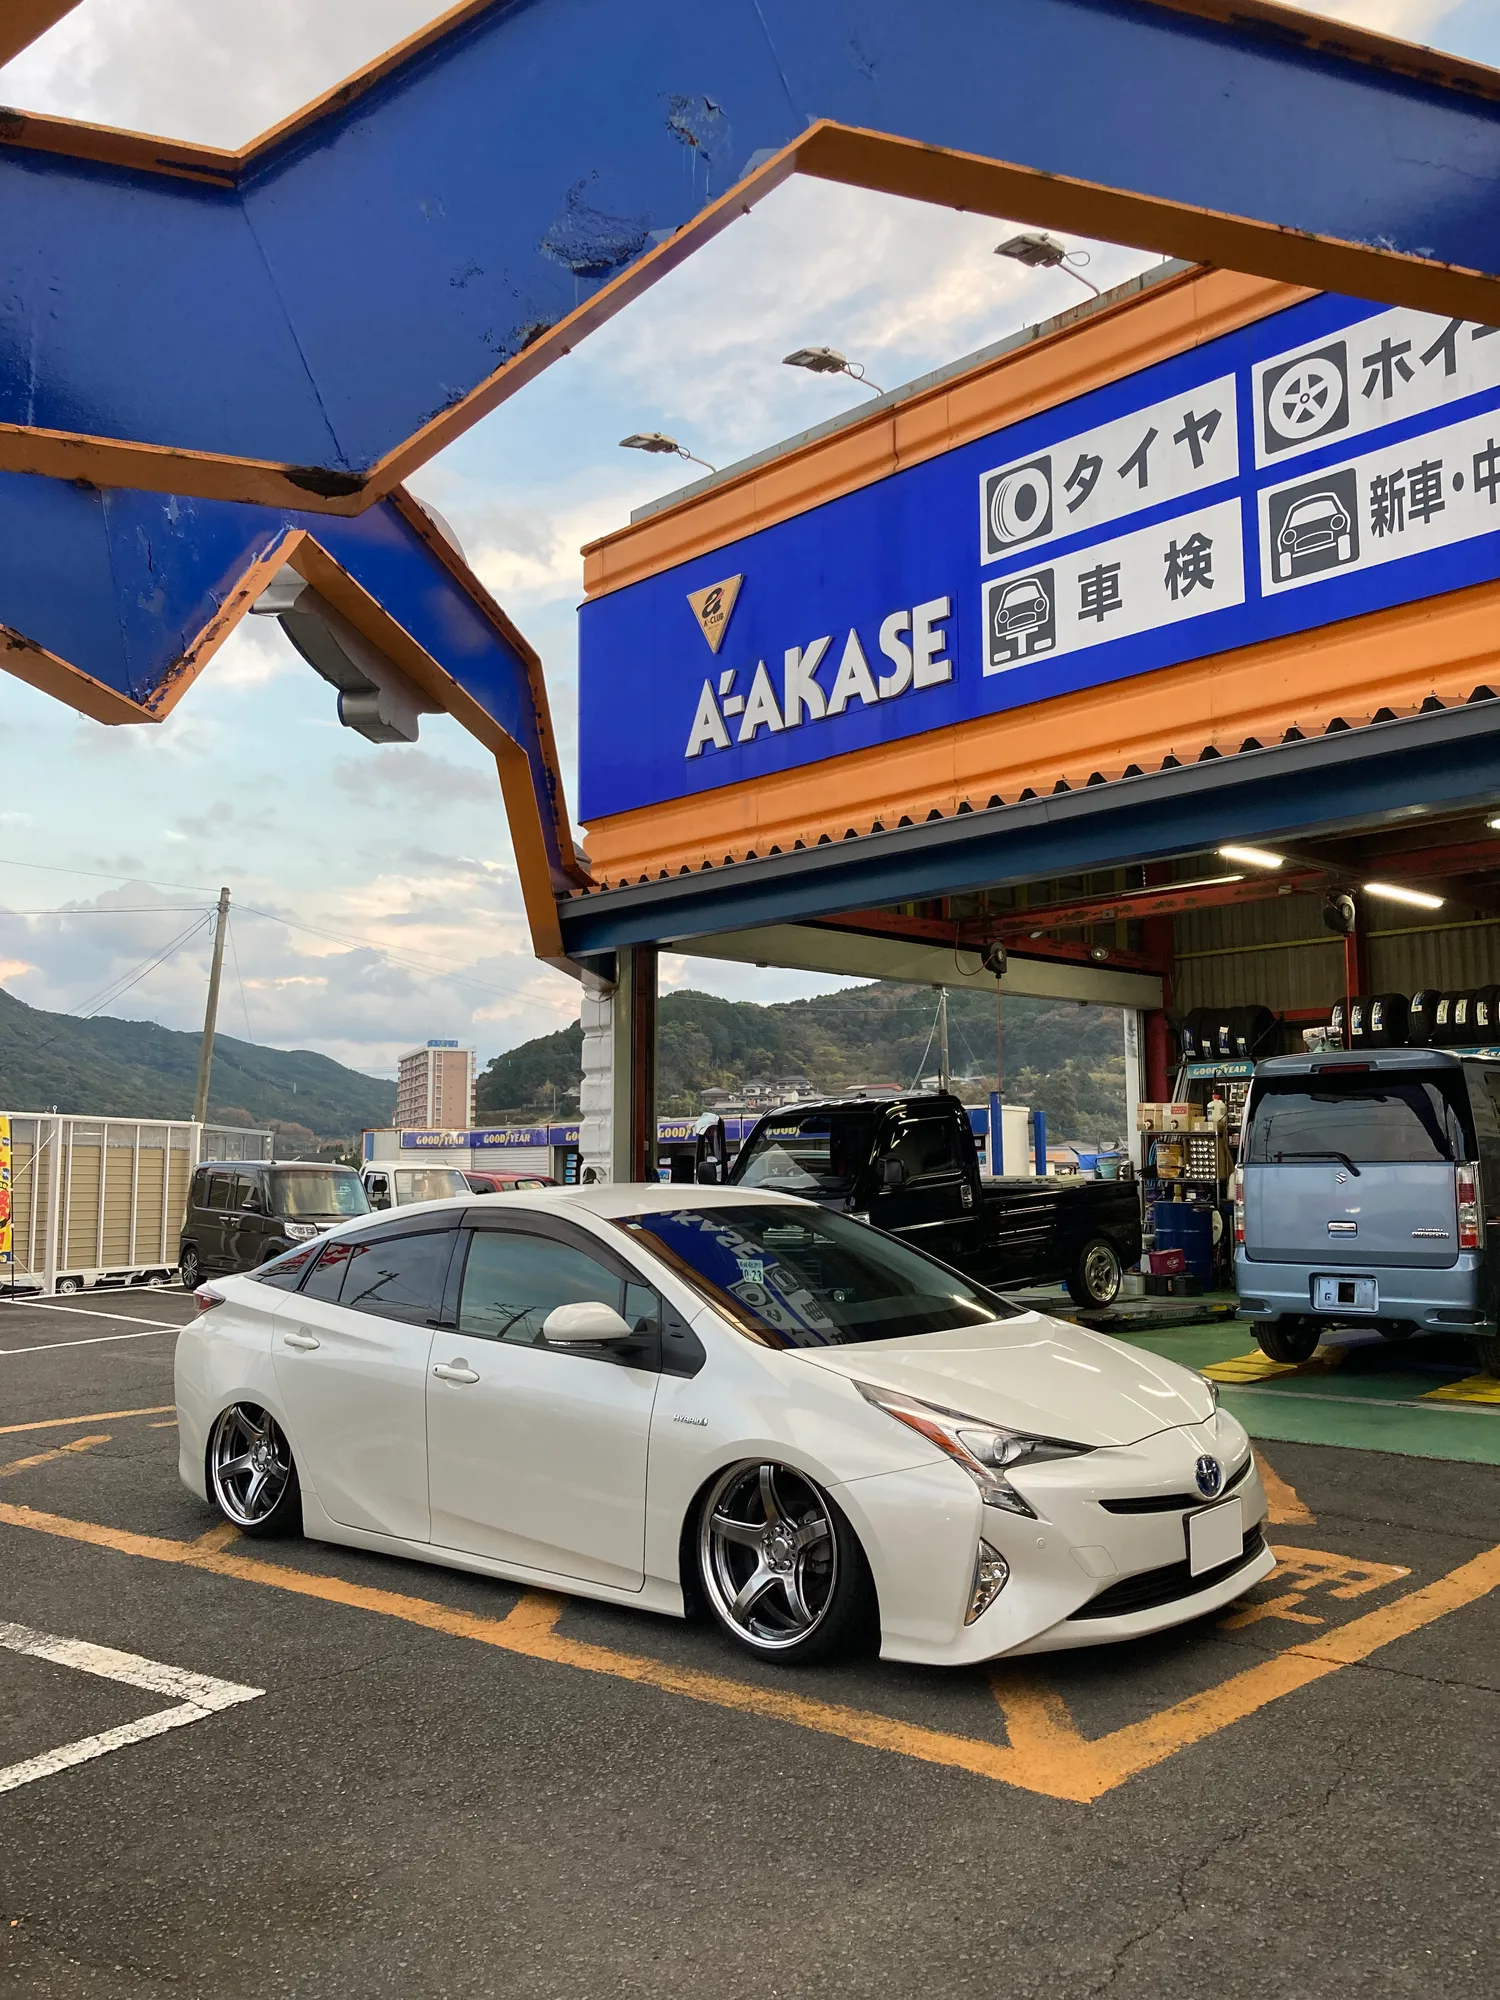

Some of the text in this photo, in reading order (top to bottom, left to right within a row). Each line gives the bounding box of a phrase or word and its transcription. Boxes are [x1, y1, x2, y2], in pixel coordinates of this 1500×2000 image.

[1063, 408, 1223, 514] タイヤ
[416, 1134, 465, 1146] GOODYEAR
[483, 1132, 531, 1145] GOODYEAR
[673, 1414, 702, 1426] HYBRID
